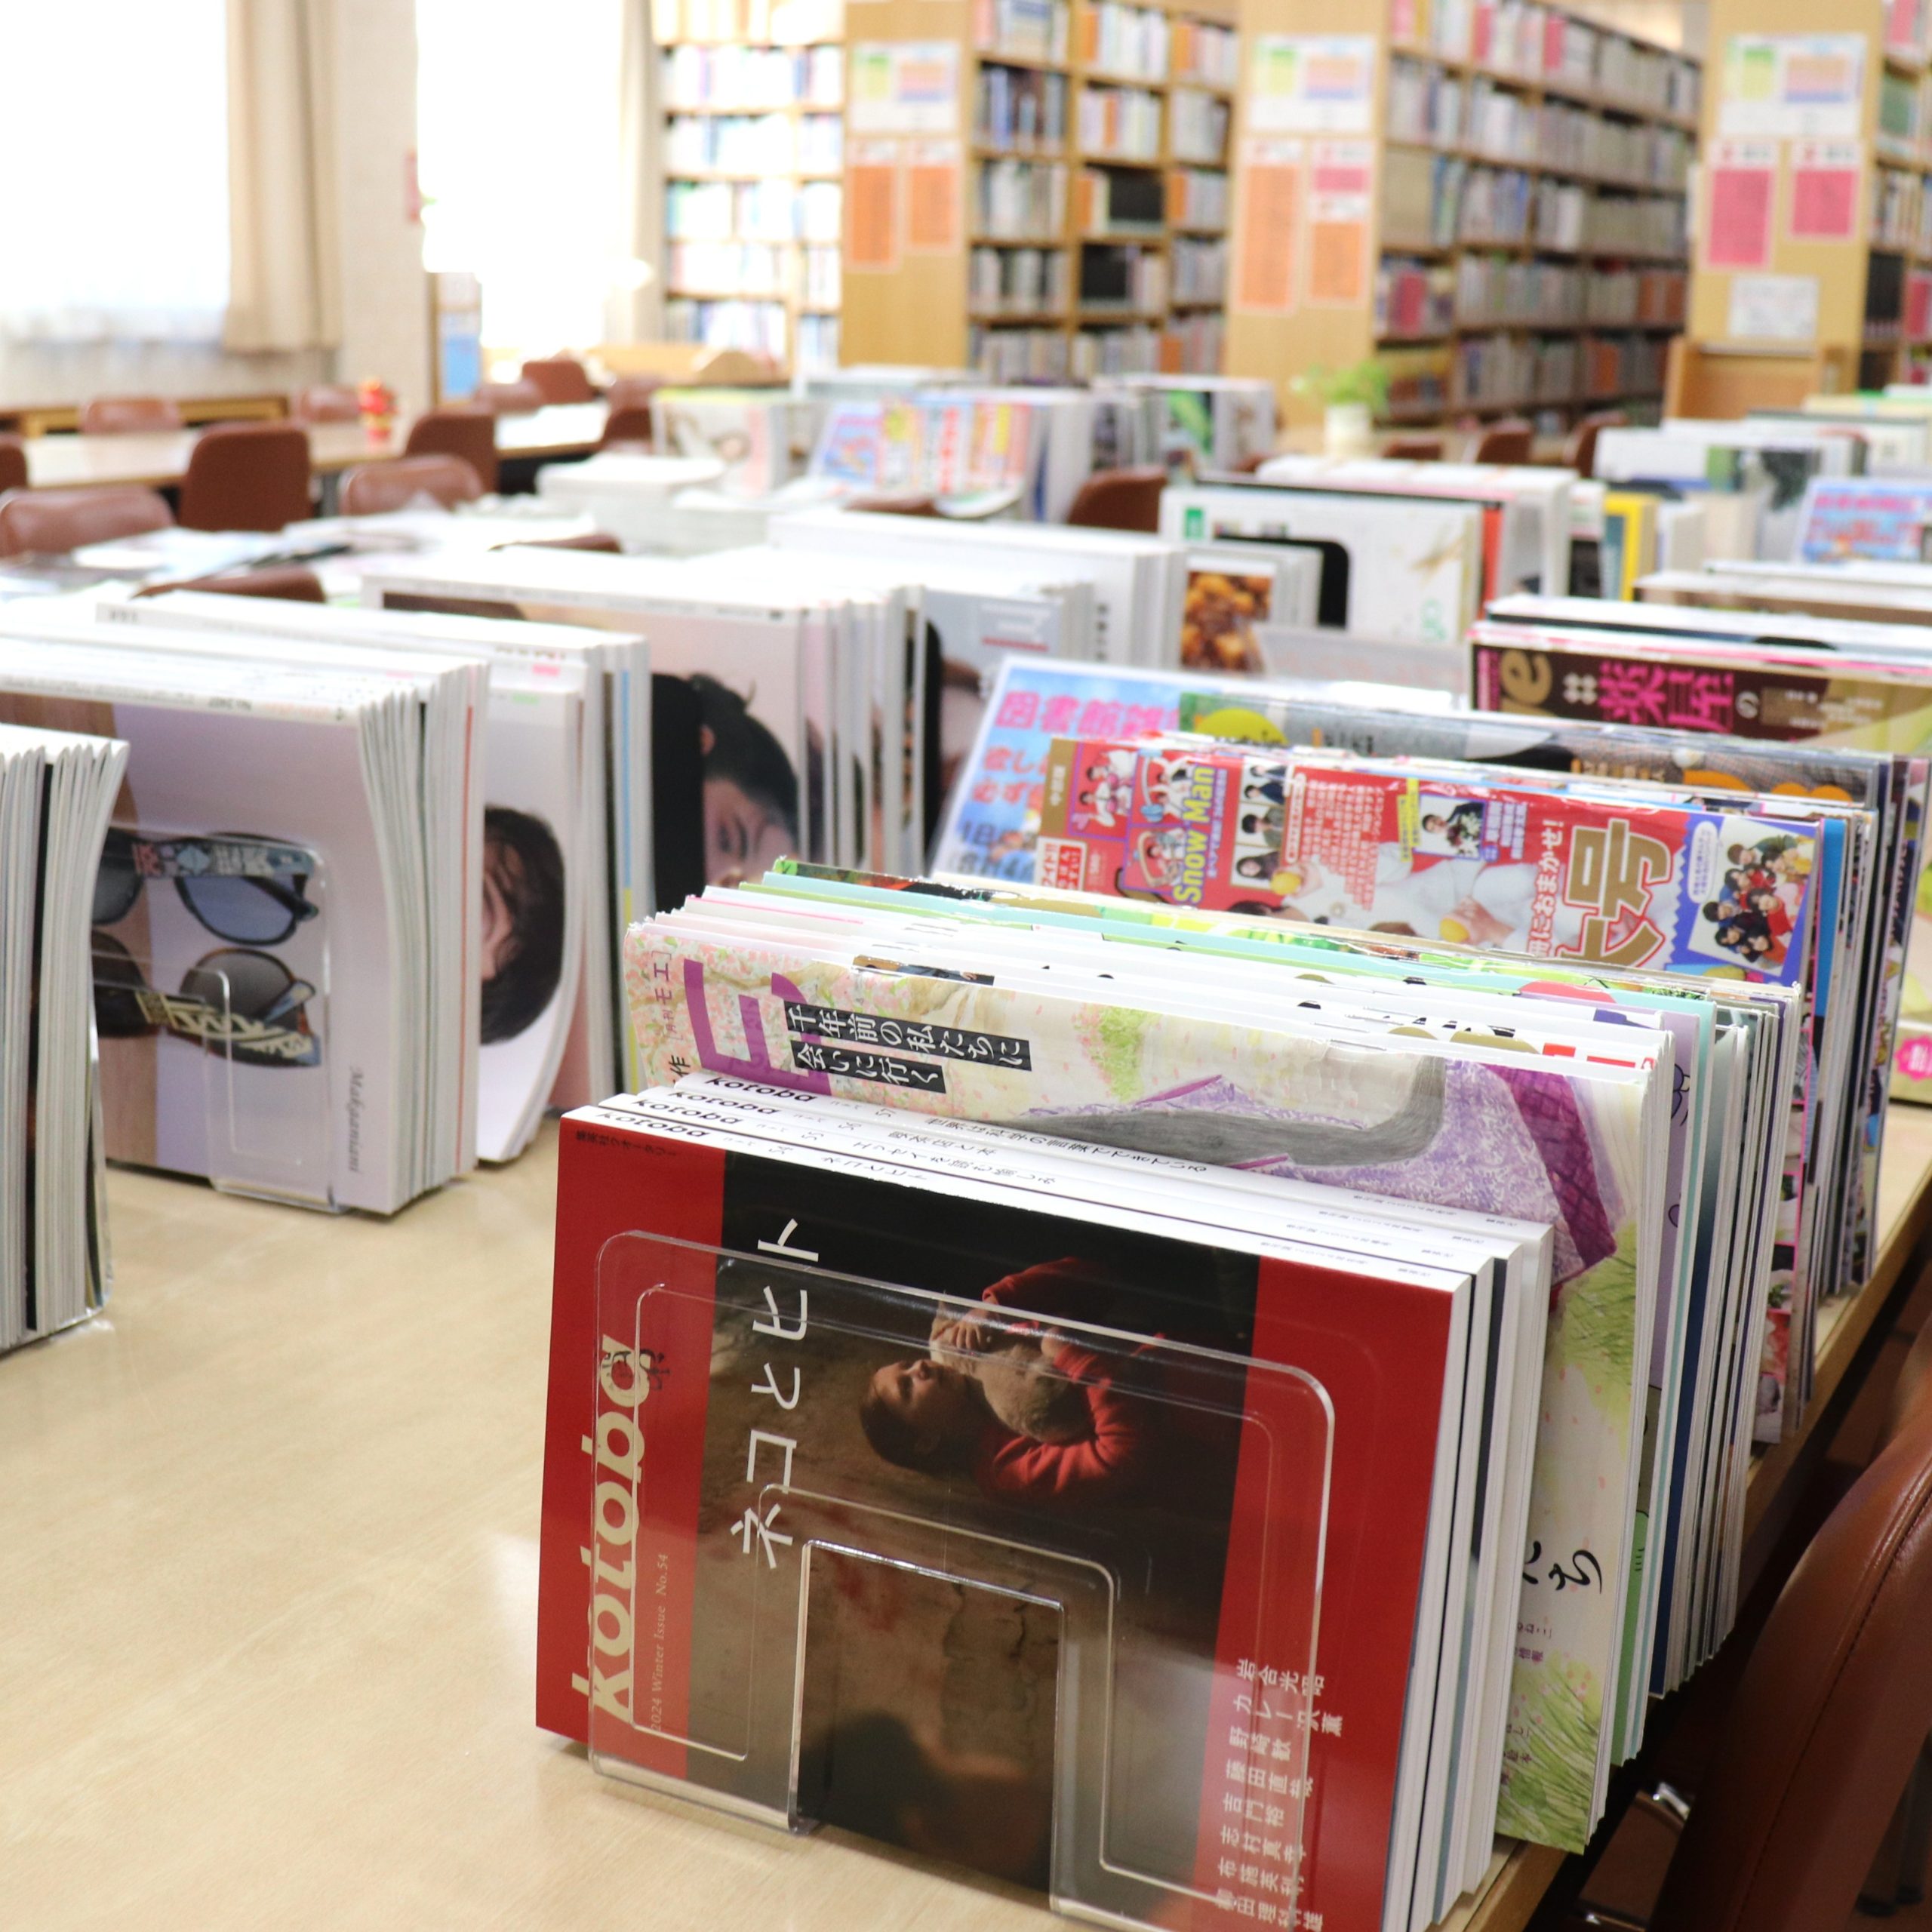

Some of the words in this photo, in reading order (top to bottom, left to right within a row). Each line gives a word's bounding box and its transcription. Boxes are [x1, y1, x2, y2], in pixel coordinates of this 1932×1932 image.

[1182, 766, 1215, 823] Man
[1172, 829, 1209, 903] Snow
[788, 1004, 1024, 1066] 千年前の私たちに
[796, 1042, 940, 1085] 会いに行く
[671, 1091, 782, 1115] kotoba
[705, 1076, 817, 1103] kotoba
[595, 1112, 712, 1138] kotoba
[633, 1099, 743, 1125] kotoba
[731, 1217, 820, 1570] ネコとヒト
[571, 1334, 651, 1727] kotoba
[655, 1553, 669, 1597] No.54
[654, 1605, 666, 1640] Issue
[652, 1644, 665, 1692] Winter
[1236, 1658, 1325, 1697] 岩合光昭
[1232, 1694, 1343, 1738] カレー沢薫
[1228, 1725, 1292, 1761] 野崎歓
[1226, 1758, 1314, 1798] 藤田直哉
[1223, 1792, 1284, 1827] 吉門裕
